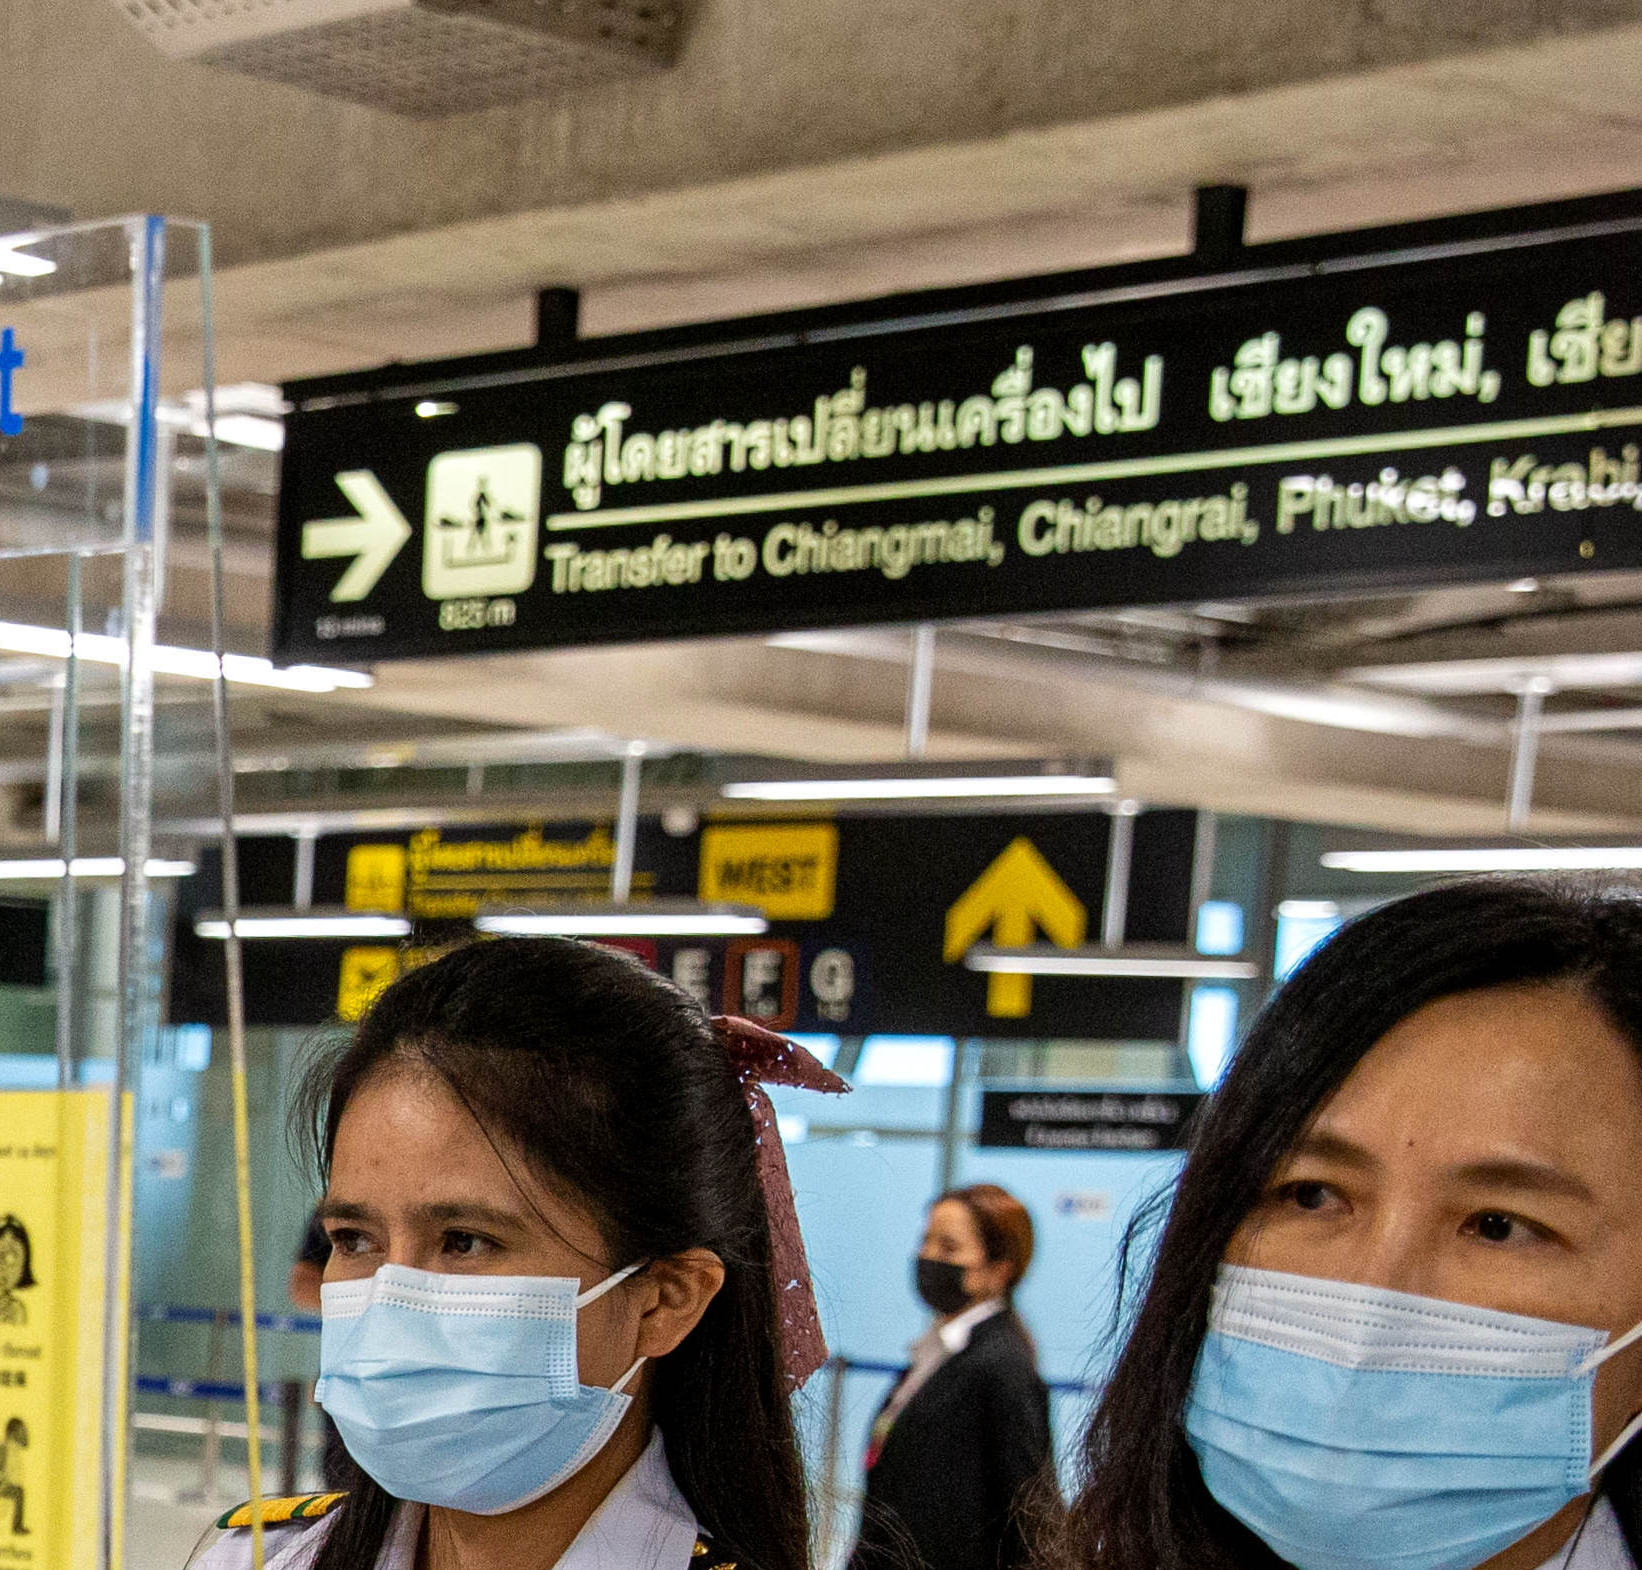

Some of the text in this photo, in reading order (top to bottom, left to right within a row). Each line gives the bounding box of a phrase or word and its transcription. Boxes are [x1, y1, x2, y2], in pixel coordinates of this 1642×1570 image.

[564, 340, 1164, 510] ผู้โดยสารเปลี่ยนเครื่องไป
[1208, 306, 1500, 422] เชียงใหม่,
[545, 533, 708, 594] Transfer
[713, 531, 756, 582] to
[762, 505, 1006, 581] Chiangmai,
[1017, 483, 1258, 557] Chiangrai,
[1275, 466, 1477, 534] Phuket,
[720, 855, 818, 897] WEST
